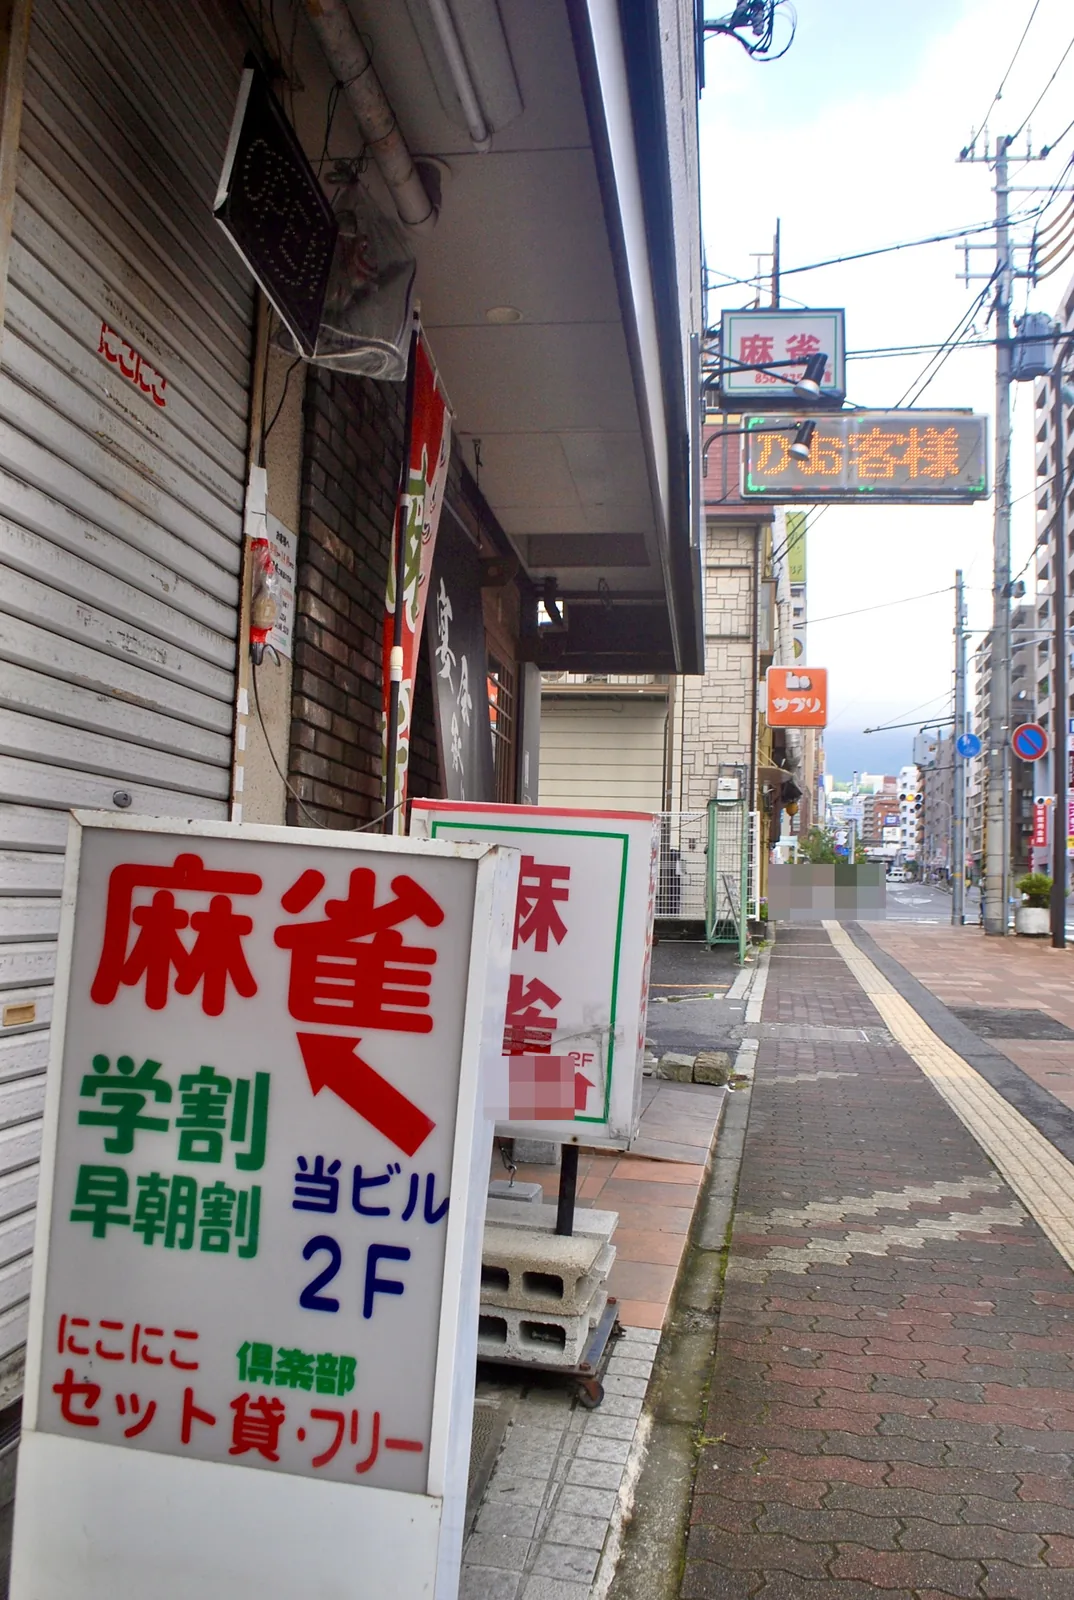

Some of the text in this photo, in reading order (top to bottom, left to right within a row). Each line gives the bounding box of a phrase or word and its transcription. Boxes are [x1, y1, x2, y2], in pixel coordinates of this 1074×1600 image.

[90, 853, 445, 1036] 麻雀
[78, 1054, 270, 1171] 学割
[70, 1165, 262, 1260] 早朝割
[293, 1155, 450, 1225] 当ビル
[299, 1234, 411, 1320] 2F
[57, 1314, 357, 1397] にこにこ 倶楽部
[52, 1368, 423, 1474] セット貸・フリー
